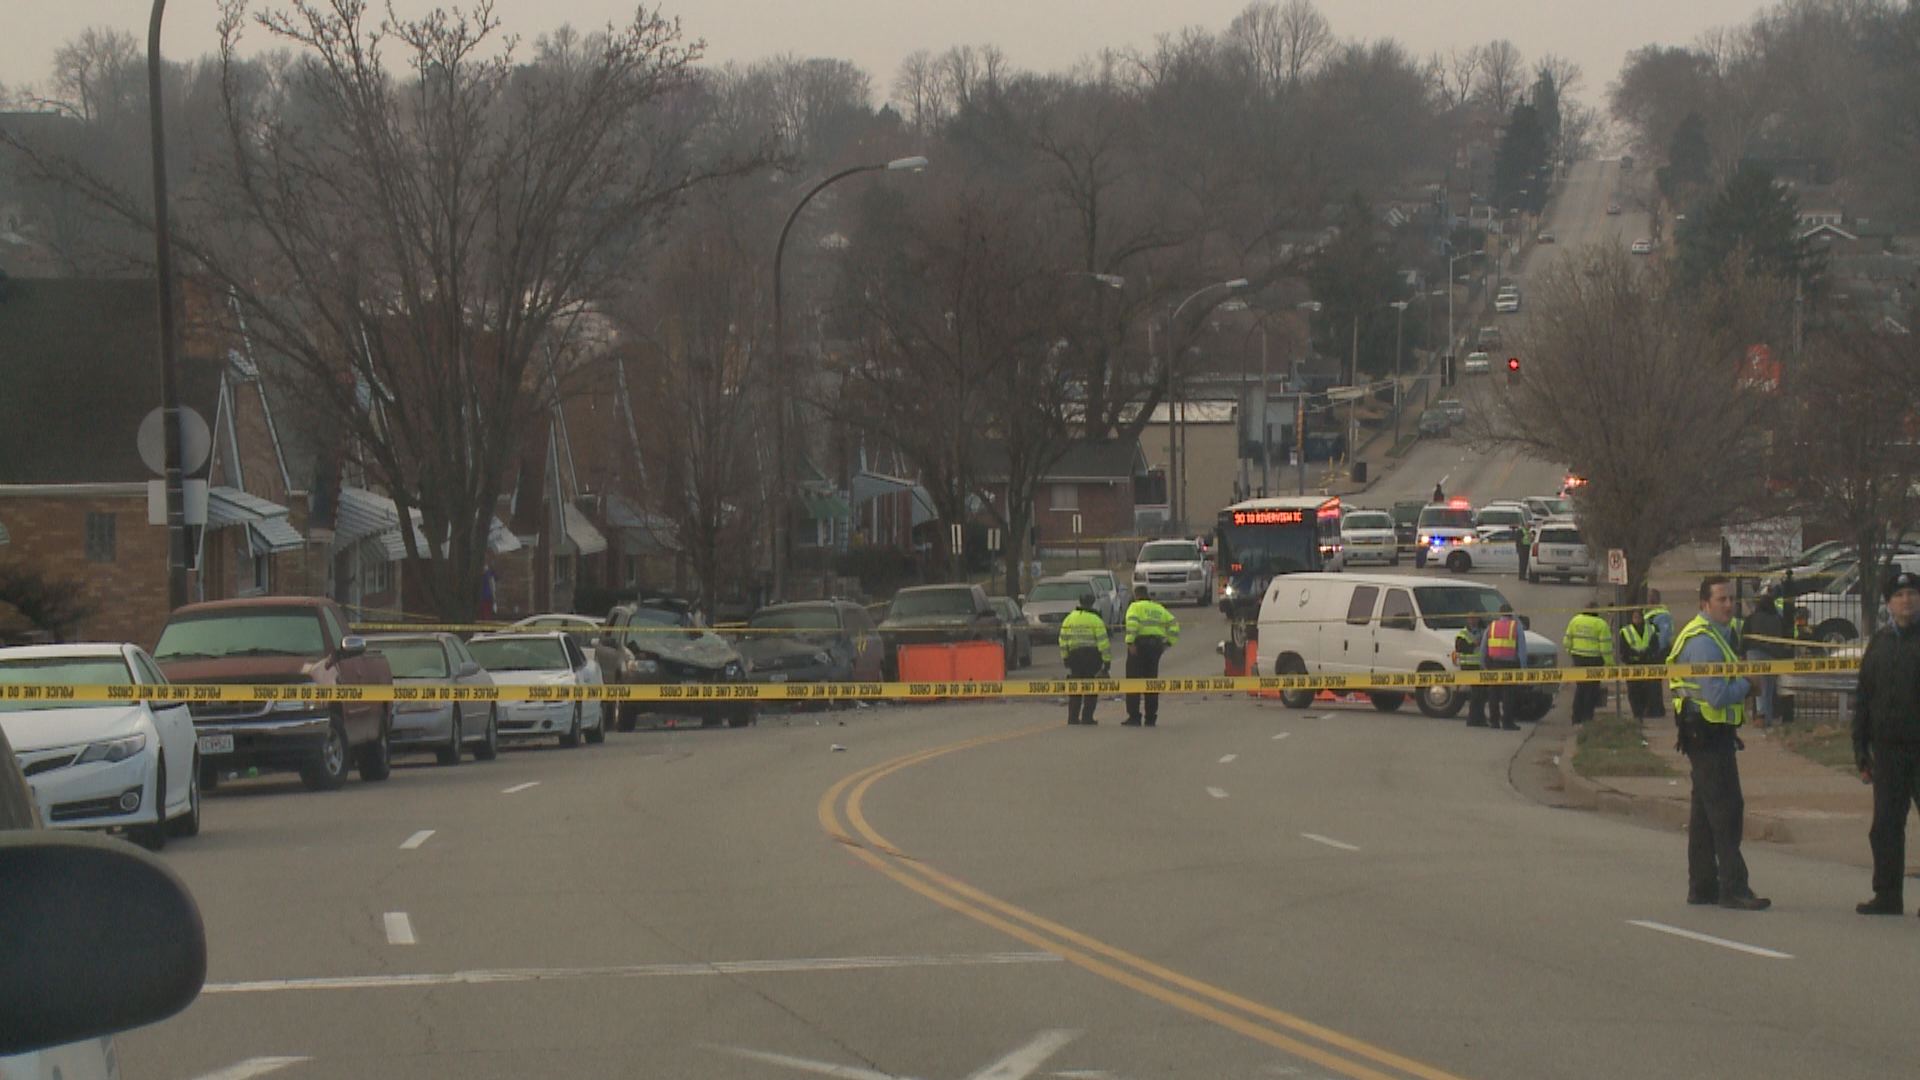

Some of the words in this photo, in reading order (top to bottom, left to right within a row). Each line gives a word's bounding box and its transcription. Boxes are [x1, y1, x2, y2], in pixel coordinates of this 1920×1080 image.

[1326, 676, 1346, 686] POLICE
[1370, 675, 1390, 685] CROSS
[1393, 675, 1404, 685] NOT
[1408, 674, 1416, 684] DO
[1419, 674, 1432, 684] LINE
[1434, 674, 1456, 684] POLICE
[1479, 672, 1498, 682] CROSS
[1502, 672, 1512, 682] NOT
[1515, 672, 1524, 681] DO
[1526, 671, 1540, 681] LINE
[1542, 671, 1562, 680] POLICE
[1068, 681, 1078, 692] DO
[1081, 681, 1095, 692] LINE
[1098, 680, 1120, 692] POLICE
[1146, 680, 1166, 691] CROSS
[1169, 680, 1182, 691] NOT
[1184, 680, 1193, 690] DO
[1196, 679, 1210, 690] LINE
[1213, 679, 1234, 690] POLICE
[1260, 678, 1280, 688] CROSS
[1282, 678, 1294, 688] NOT
[1297, 677, 1306, 688] DO
[1309, 676, 1322, 687] LINE
[8, 686, 19, 698] DO
[24, 686, 41, 698] LINE
[46, 686, 74, 698] POLICE
[108, 686, 134, 698] CROSS
[138, 686, 153, 698] NOT
[158, 686, 168, 698] DO
[172, 686, 190, 698] LINE
[193, 686, 221, 698] POLICE
[254, 687, 279, 699] CROSS
[282, 687, 297, 699] NOT
[301, 687, 311, 699] DO
[315, 687, 332, 699] LINE
[336, 687, 362, 699] POLICE
[393, 687, 418, 699] CROSS
[421, 687, 436, 699] NOT
[440, 687, 450, 699] DO
[454, 687, 470, 699] LINE
[473, 687, 499, 699] POLICE
[529, 687, 552, 698] CROSS
[556, 687, 570, 698] NOT
[573, 687, 583, 698] DO
[587, 687, 602, 698] LINE
[606, 686, 631, 698] POLICE
[660, 686, 682, 698] CROSS
[686, 686, 699, 697] NOT
[702, 686, 712, 697] DO
[716, 686, 731, 697] LINE
[735, 686, 759, 697] POLICE
[786, 686, 808, 696] CROSS
[812, 685, 825, 696] NOT
[828, 685, 838, 696] DO
[841, 685, 856, 696] LINE
[859, 684, 882, 696] POLICE
[910, 684, 931, 695] CROSS
[934, 684, 947, 695] NOT
[950, 683, 960, 694] DO
[963, 683, 976, 694] LINE
[980, 682, 1003, 694] POLICE
[1028, 682, 1050, 693] CROSS
[1053, 682, 1065, 693] NOT
